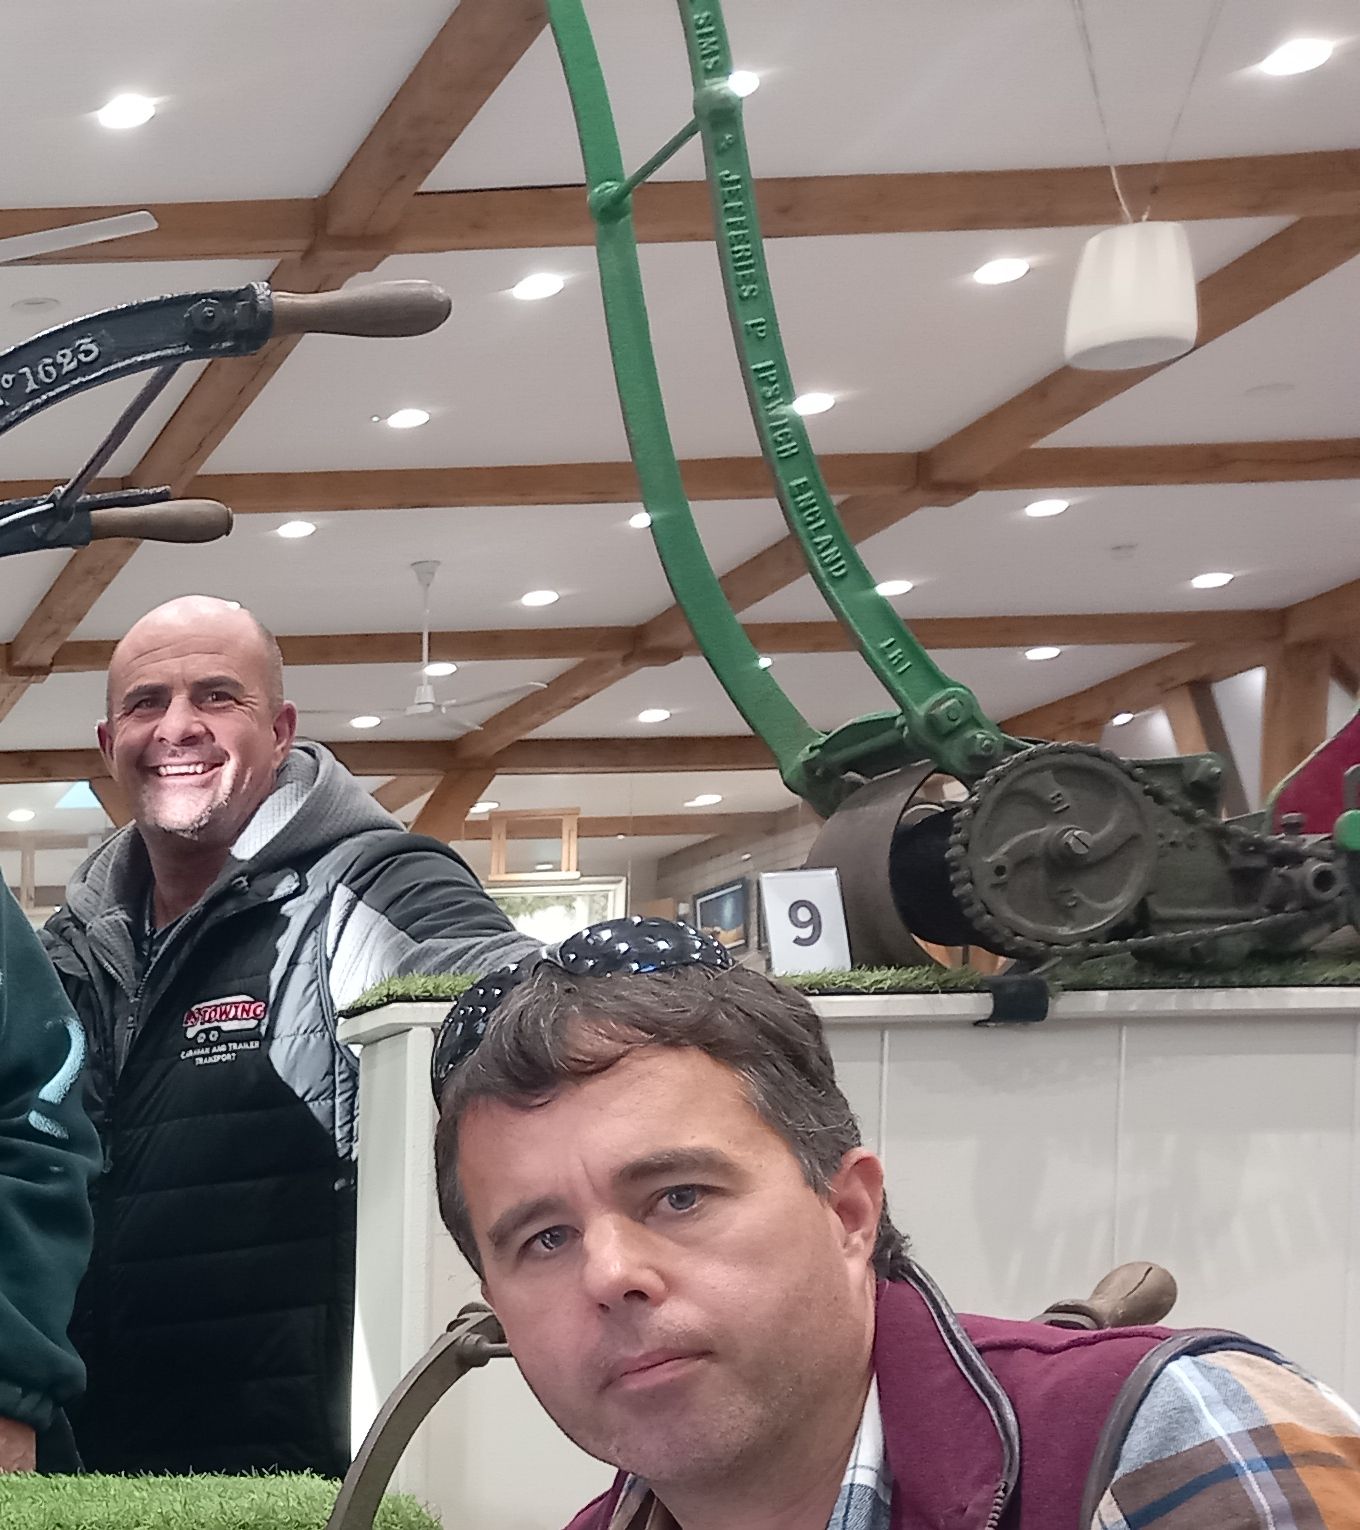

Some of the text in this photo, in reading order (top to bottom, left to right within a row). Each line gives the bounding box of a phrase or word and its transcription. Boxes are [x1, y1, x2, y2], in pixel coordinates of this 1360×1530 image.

[751, 360, 799, 458] IPSWICH
[789, 476, 847, 578] ENGLAND
[788, 899, 822, 947] 9
[202, 1001, 267, 1023] TOWING
[211, 1044, 227, 1054] AND
[228, 1040, 260, 1051] TRAILER
[195, 1052, 237, 1066] TRANSPORT
